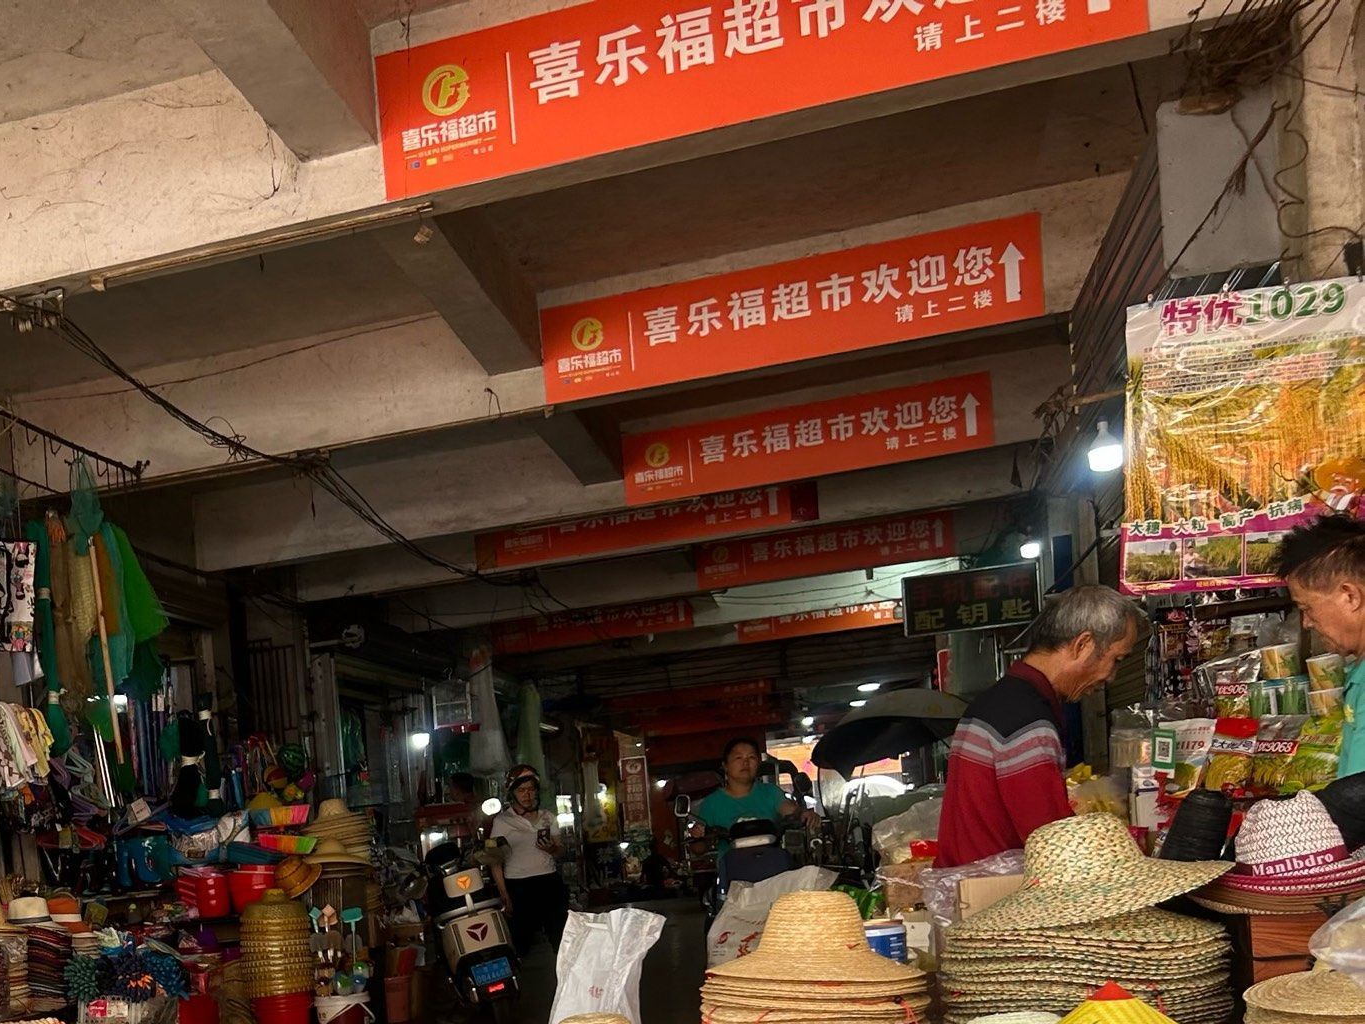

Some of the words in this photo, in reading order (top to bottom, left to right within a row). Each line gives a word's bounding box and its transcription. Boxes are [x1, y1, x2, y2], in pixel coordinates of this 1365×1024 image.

[913, 0, 1067, 53] 请上二楼
[528, 0, 973, 104] 喜乐福超市
[402, 110, 497, 152] 喜乐福超市
[643, 246, 994, 347] 喜乐福超市欢迎您
[894, 291, 993, 324] 请上二楼
[1161, 283, 1346, 337] 特优1029
[557, 348, 622, 374] 喜乐福超市
[699, 395, 959, 465] 喜乐福超市欢迎您
[885, 427, 957, 451] 请上二楼
[1174, 517, 1207, 535] 大粒
[1220, 509, 1255, 528] 高产
[1268, 498, 1305, 519] 抗病
[751, 520, 931, 563] 喜乐福超市欢迎您
[914, 599, 1031, 631] 配钥匙
